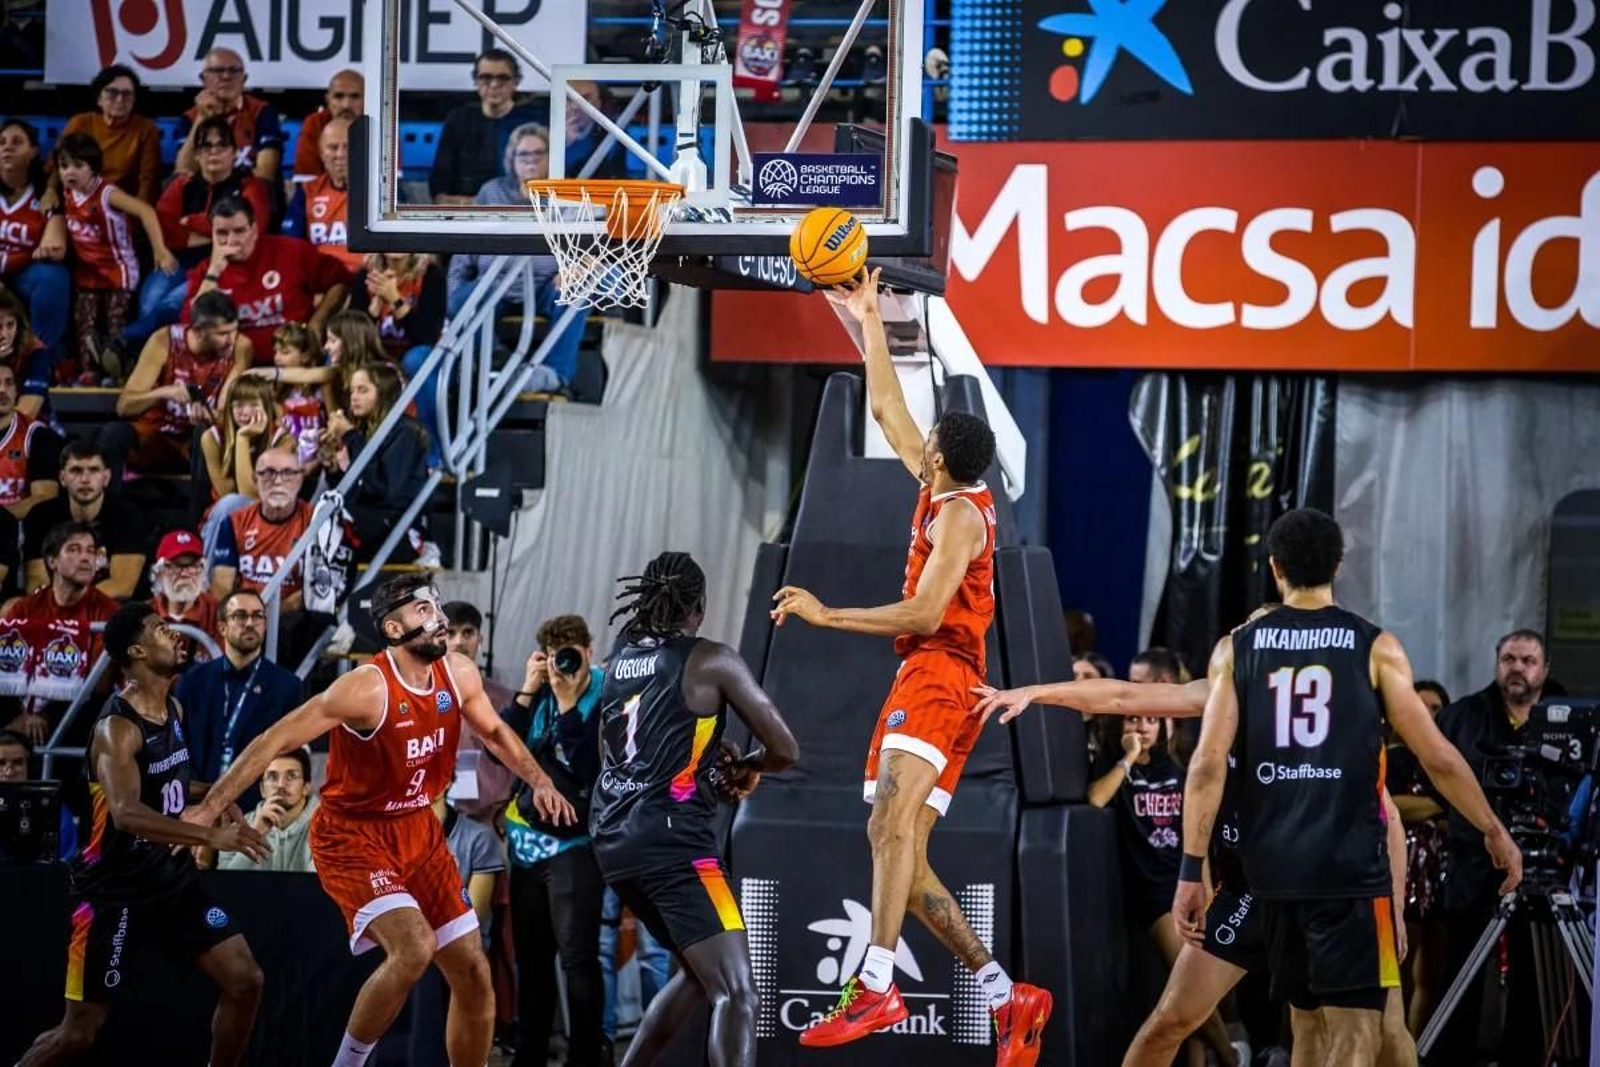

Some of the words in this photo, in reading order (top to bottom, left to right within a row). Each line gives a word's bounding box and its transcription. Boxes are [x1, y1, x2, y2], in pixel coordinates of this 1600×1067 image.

[800, 165, 867, 174] BASKETBALL
[800, 175, 876, 185] CHAMPIONS
[800, 185, 841, 194] LEAGUE
[1253, 627, 1355, 650] NKAMHOUA
[1268, 664, 1333, 748] 13
[622, 693, 642, 763] 1
[1569, 738, 1582, 760] 3
[405, 768, 426, 797] 9
[1277, 763, 1343, 780] Staffbase
[161, 779, 184, 815] 10
[371, 876, 392, 889] ETL
[110, 907, 129, 967] Staffbase
